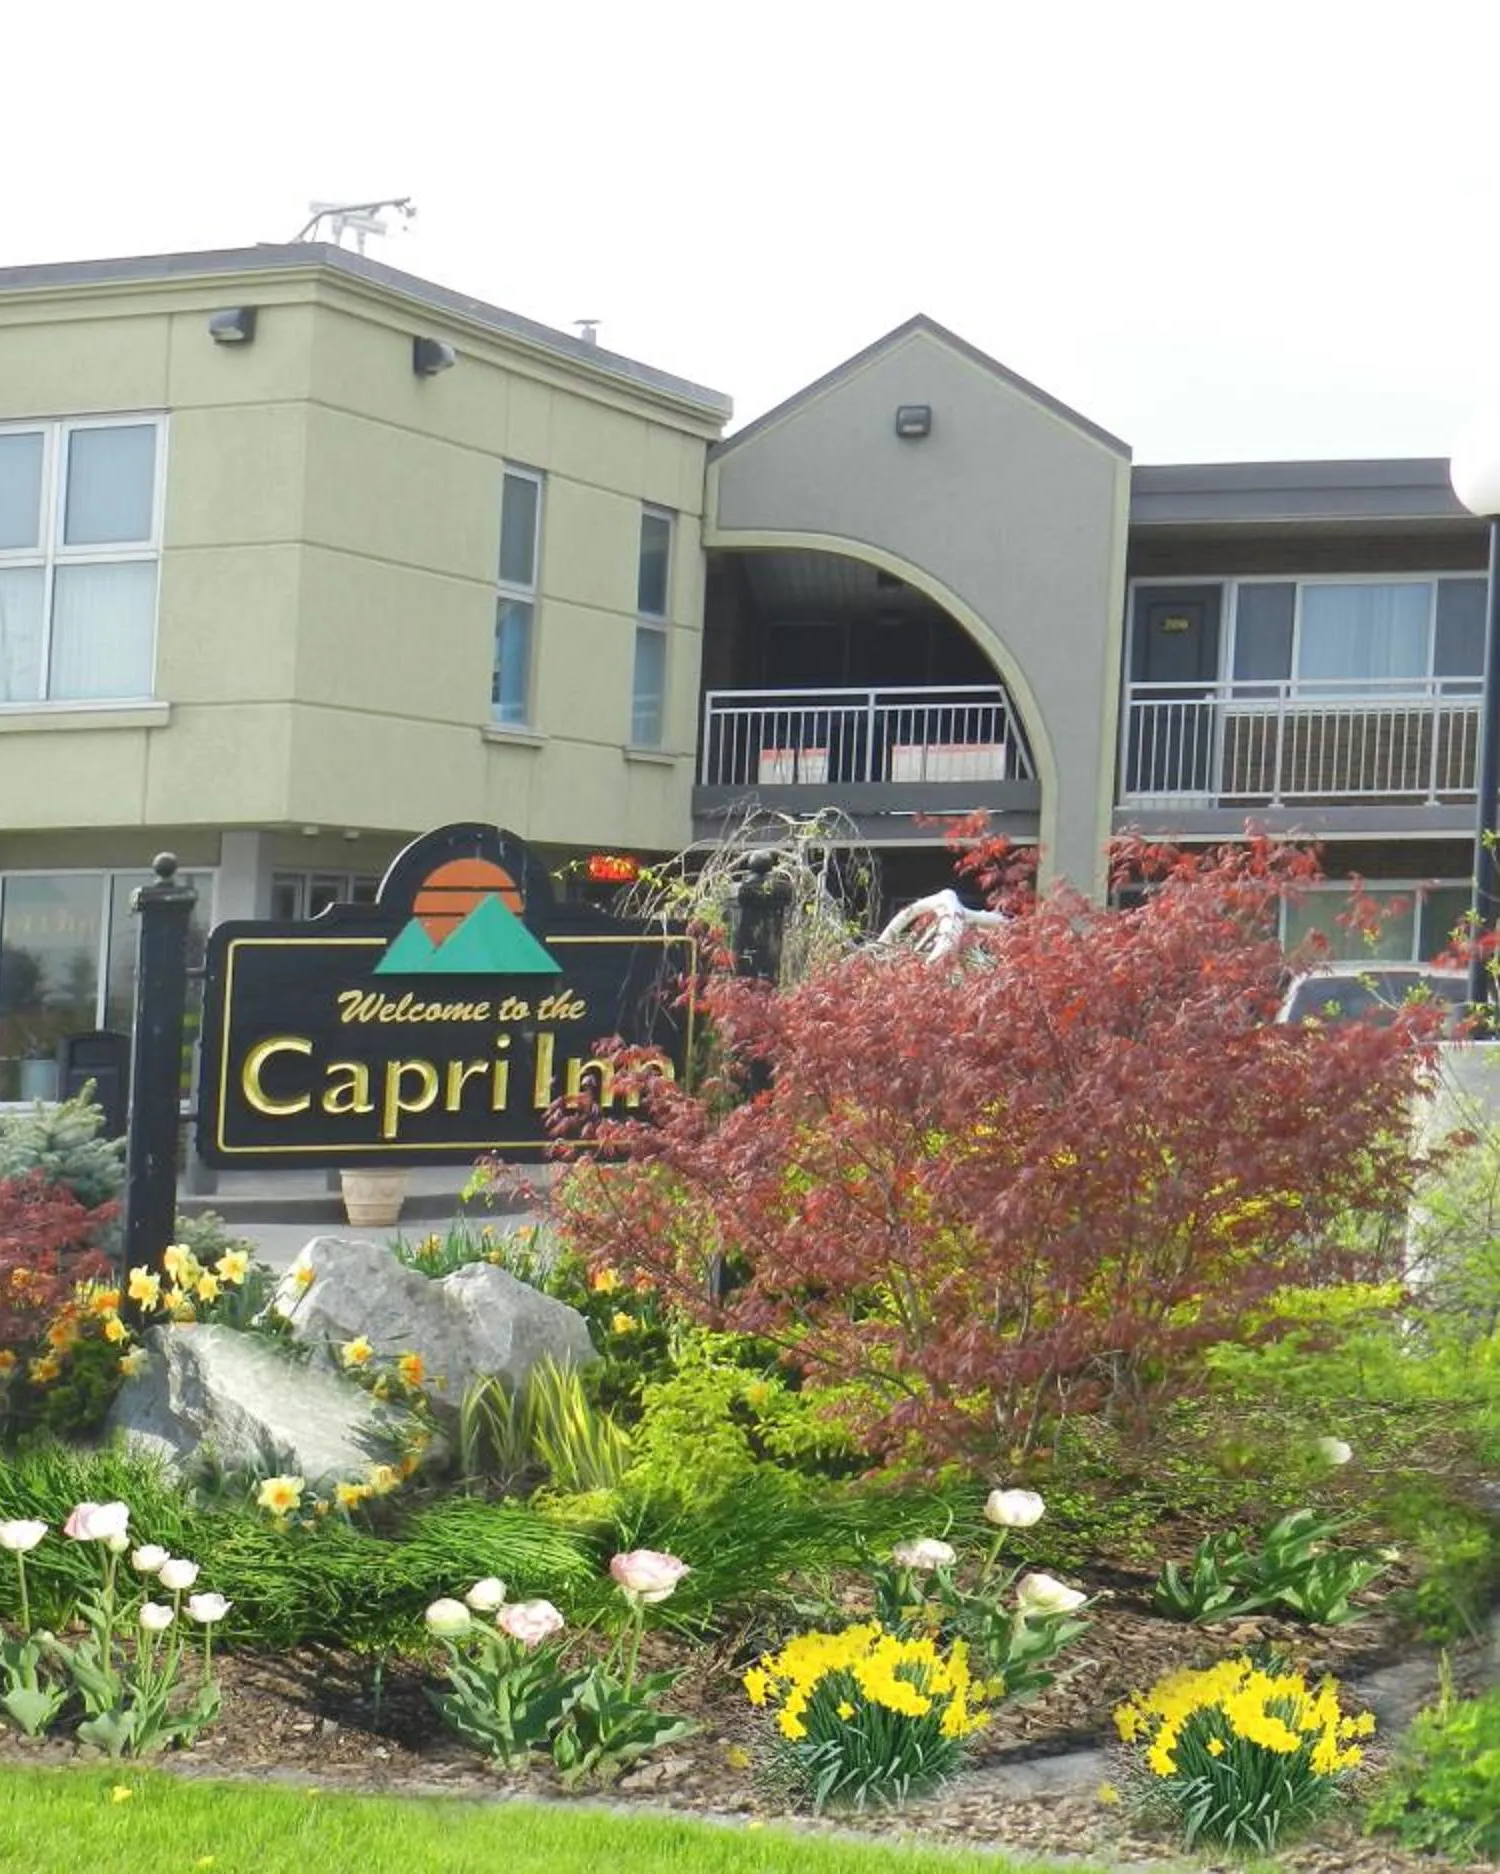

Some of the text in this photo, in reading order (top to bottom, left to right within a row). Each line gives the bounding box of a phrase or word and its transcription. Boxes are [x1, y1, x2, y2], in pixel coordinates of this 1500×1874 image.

[337, 988, 587, 1023] Welcome to the
[241, 1033, 512, 1139] Capri
